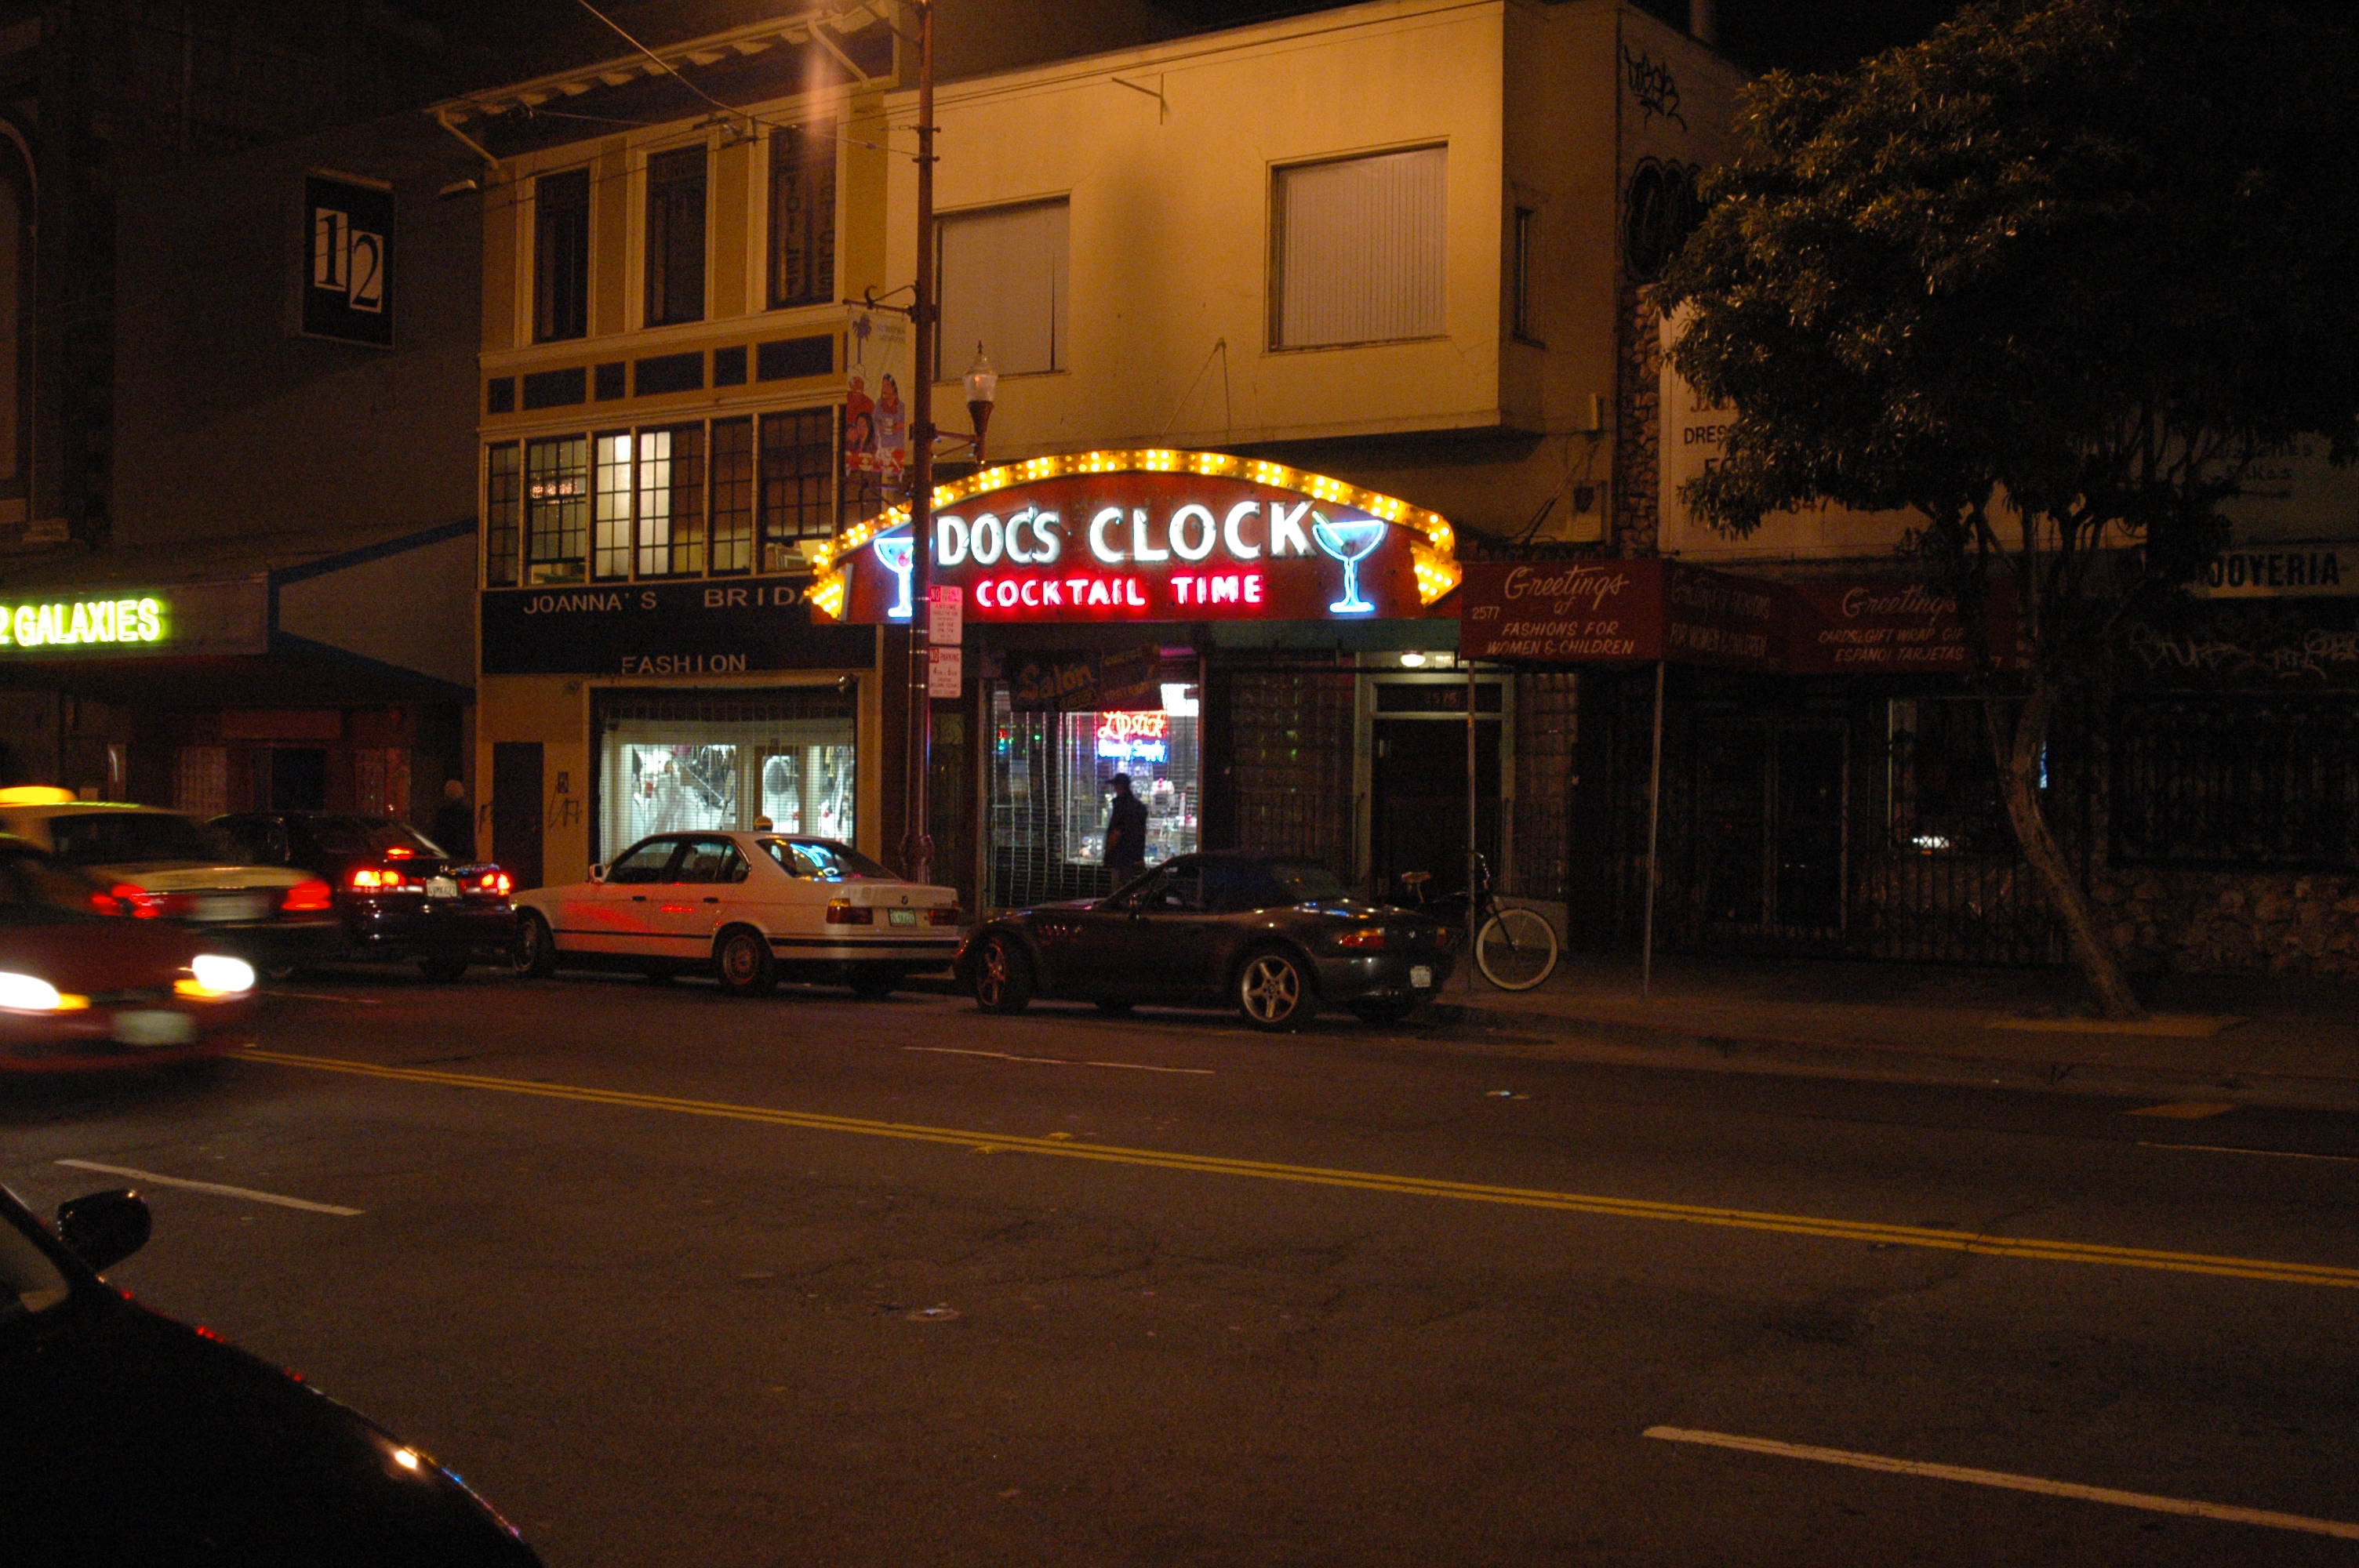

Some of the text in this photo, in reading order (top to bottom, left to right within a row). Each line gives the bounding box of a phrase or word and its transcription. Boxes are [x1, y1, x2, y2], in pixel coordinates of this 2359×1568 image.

[318, 212, 380, 308] 12
[1684, 425, 1734, 445] DRES
[936, 499, 1319, 566] DOC'S CLOCK
[976, 577, 1146, 608] COCKTAIL
[1171, 575, 1266, 604] TIME
[1503, 564, 1630, 611] Greetings
[522, 590, 659, 615] JOANNA'S
[1471, 606, 1500, 620] 2577
[1553, 597, 1577, 615] of
[1841, 583, 1957, 626] Greetings
[14, 597, 160, 647] GALAXIES
[1501, 620, 1620, 637] FASHIONS FOR
[1896, 627, 1936, 642] WRAP
[1942, 626, 1966, 641] GIF
[1486, 640, 1542, 655] WOMEN
[1559, 640, 1635, 655] CHILDREN
[1896, 646, 1965, 662] TARJETAS
[621, 653, 747, 675] FASHION
